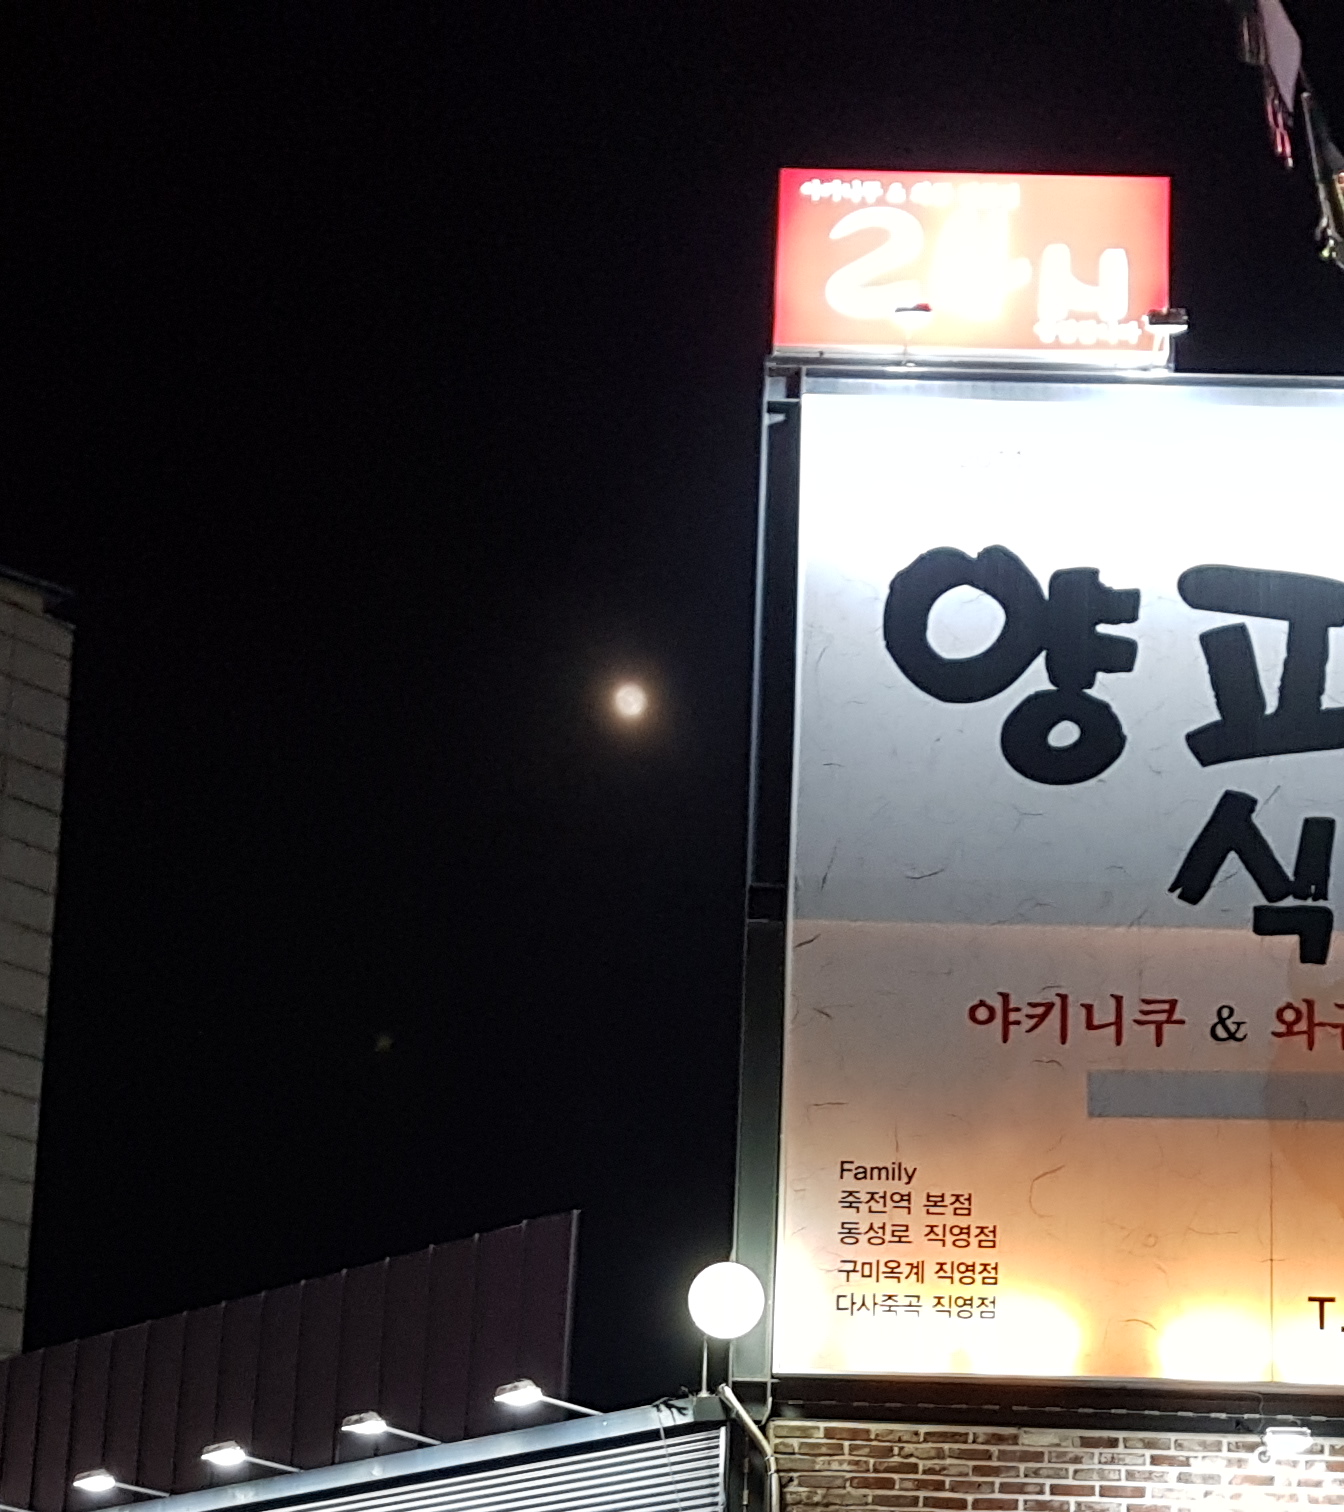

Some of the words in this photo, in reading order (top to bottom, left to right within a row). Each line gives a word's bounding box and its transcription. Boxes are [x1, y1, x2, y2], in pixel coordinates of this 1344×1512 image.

[968, 993, 1186, 1047] 야키니쿠
[1209, 1005, 1248, 1043] &
[839, 1160, 918, 1186] Family
[837, 1189, 912, 1215] 죽전역
[922, 1191, 973, 1217] 본점
[837, 1221, 913, 1246] 동성로
[923, 1223, 998, 1249] 직영점
[837, 1259, 925, 1284] 구미옥계
[934, 1260, 999, 1286] 직영점
[835, 1292, 923, 1318] 다사죽곡
[932, 1294, 996, 1320] 직영점
